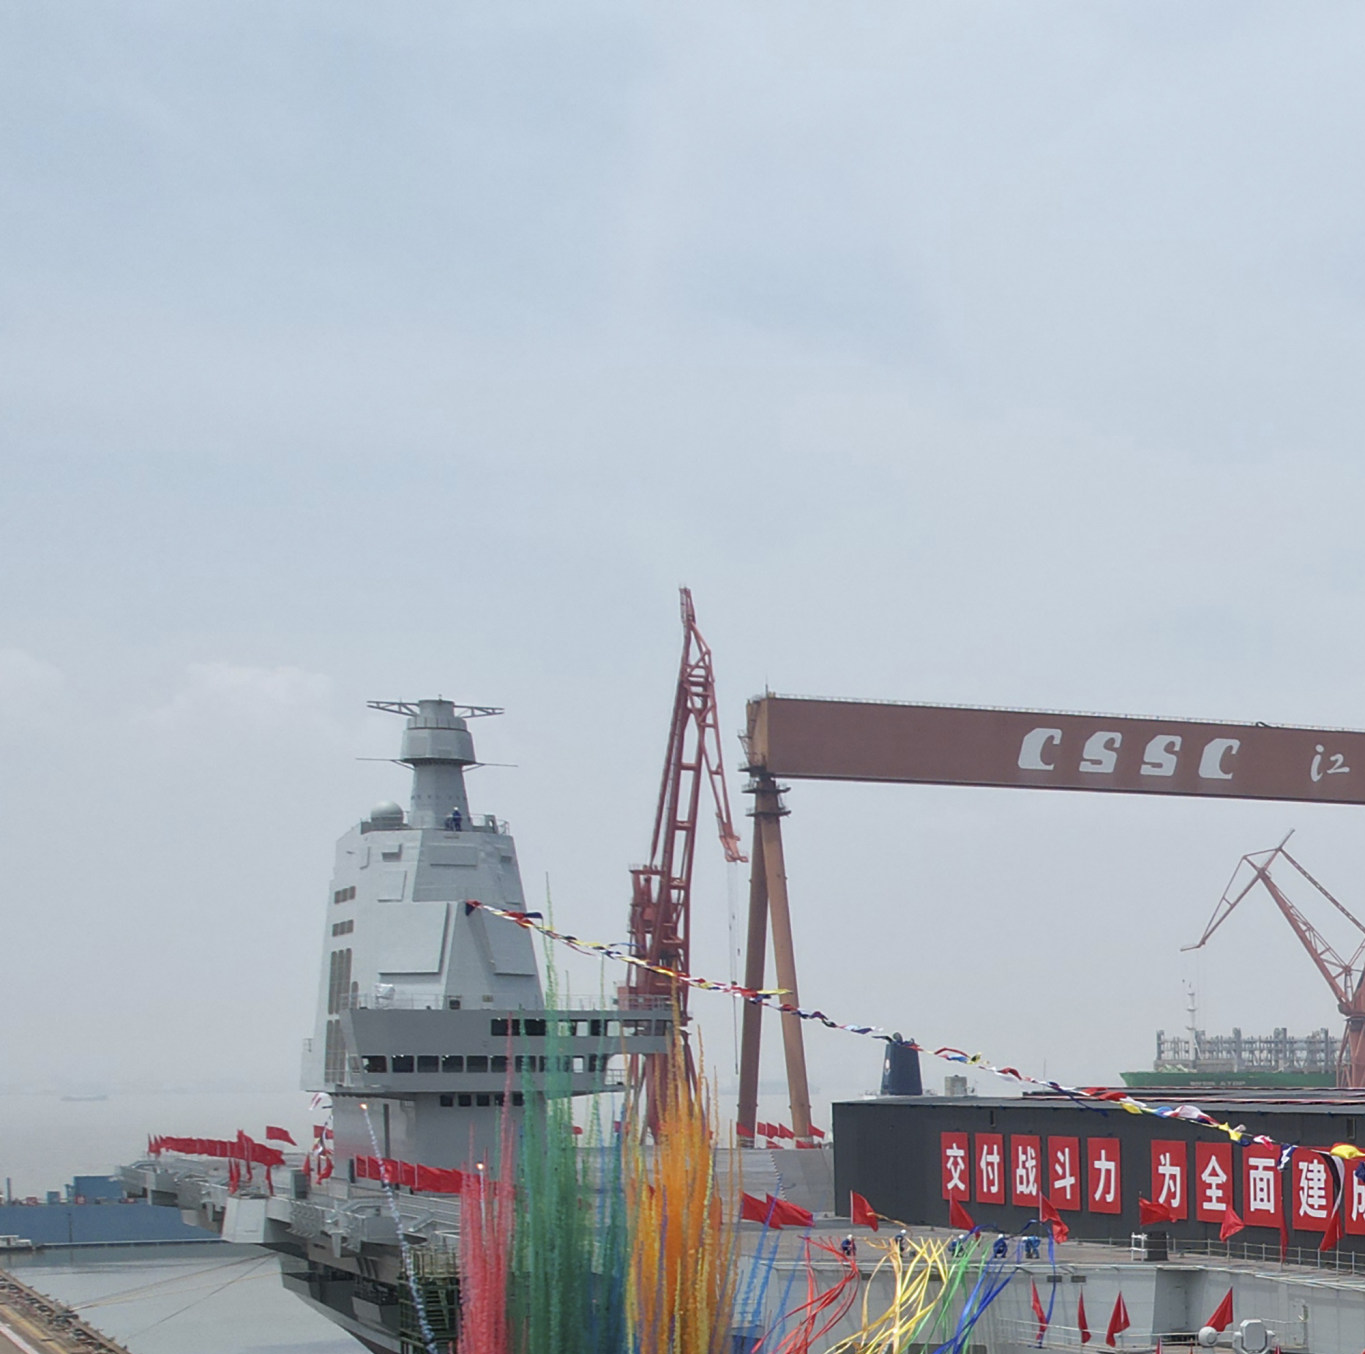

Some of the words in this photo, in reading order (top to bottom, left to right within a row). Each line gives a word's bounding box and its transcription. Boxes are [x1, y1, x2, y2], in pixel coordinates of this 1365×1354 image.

[1018, 728, 1242, 780] CSSC
[945, 1143, 1116, 1203] 交付战斗力
